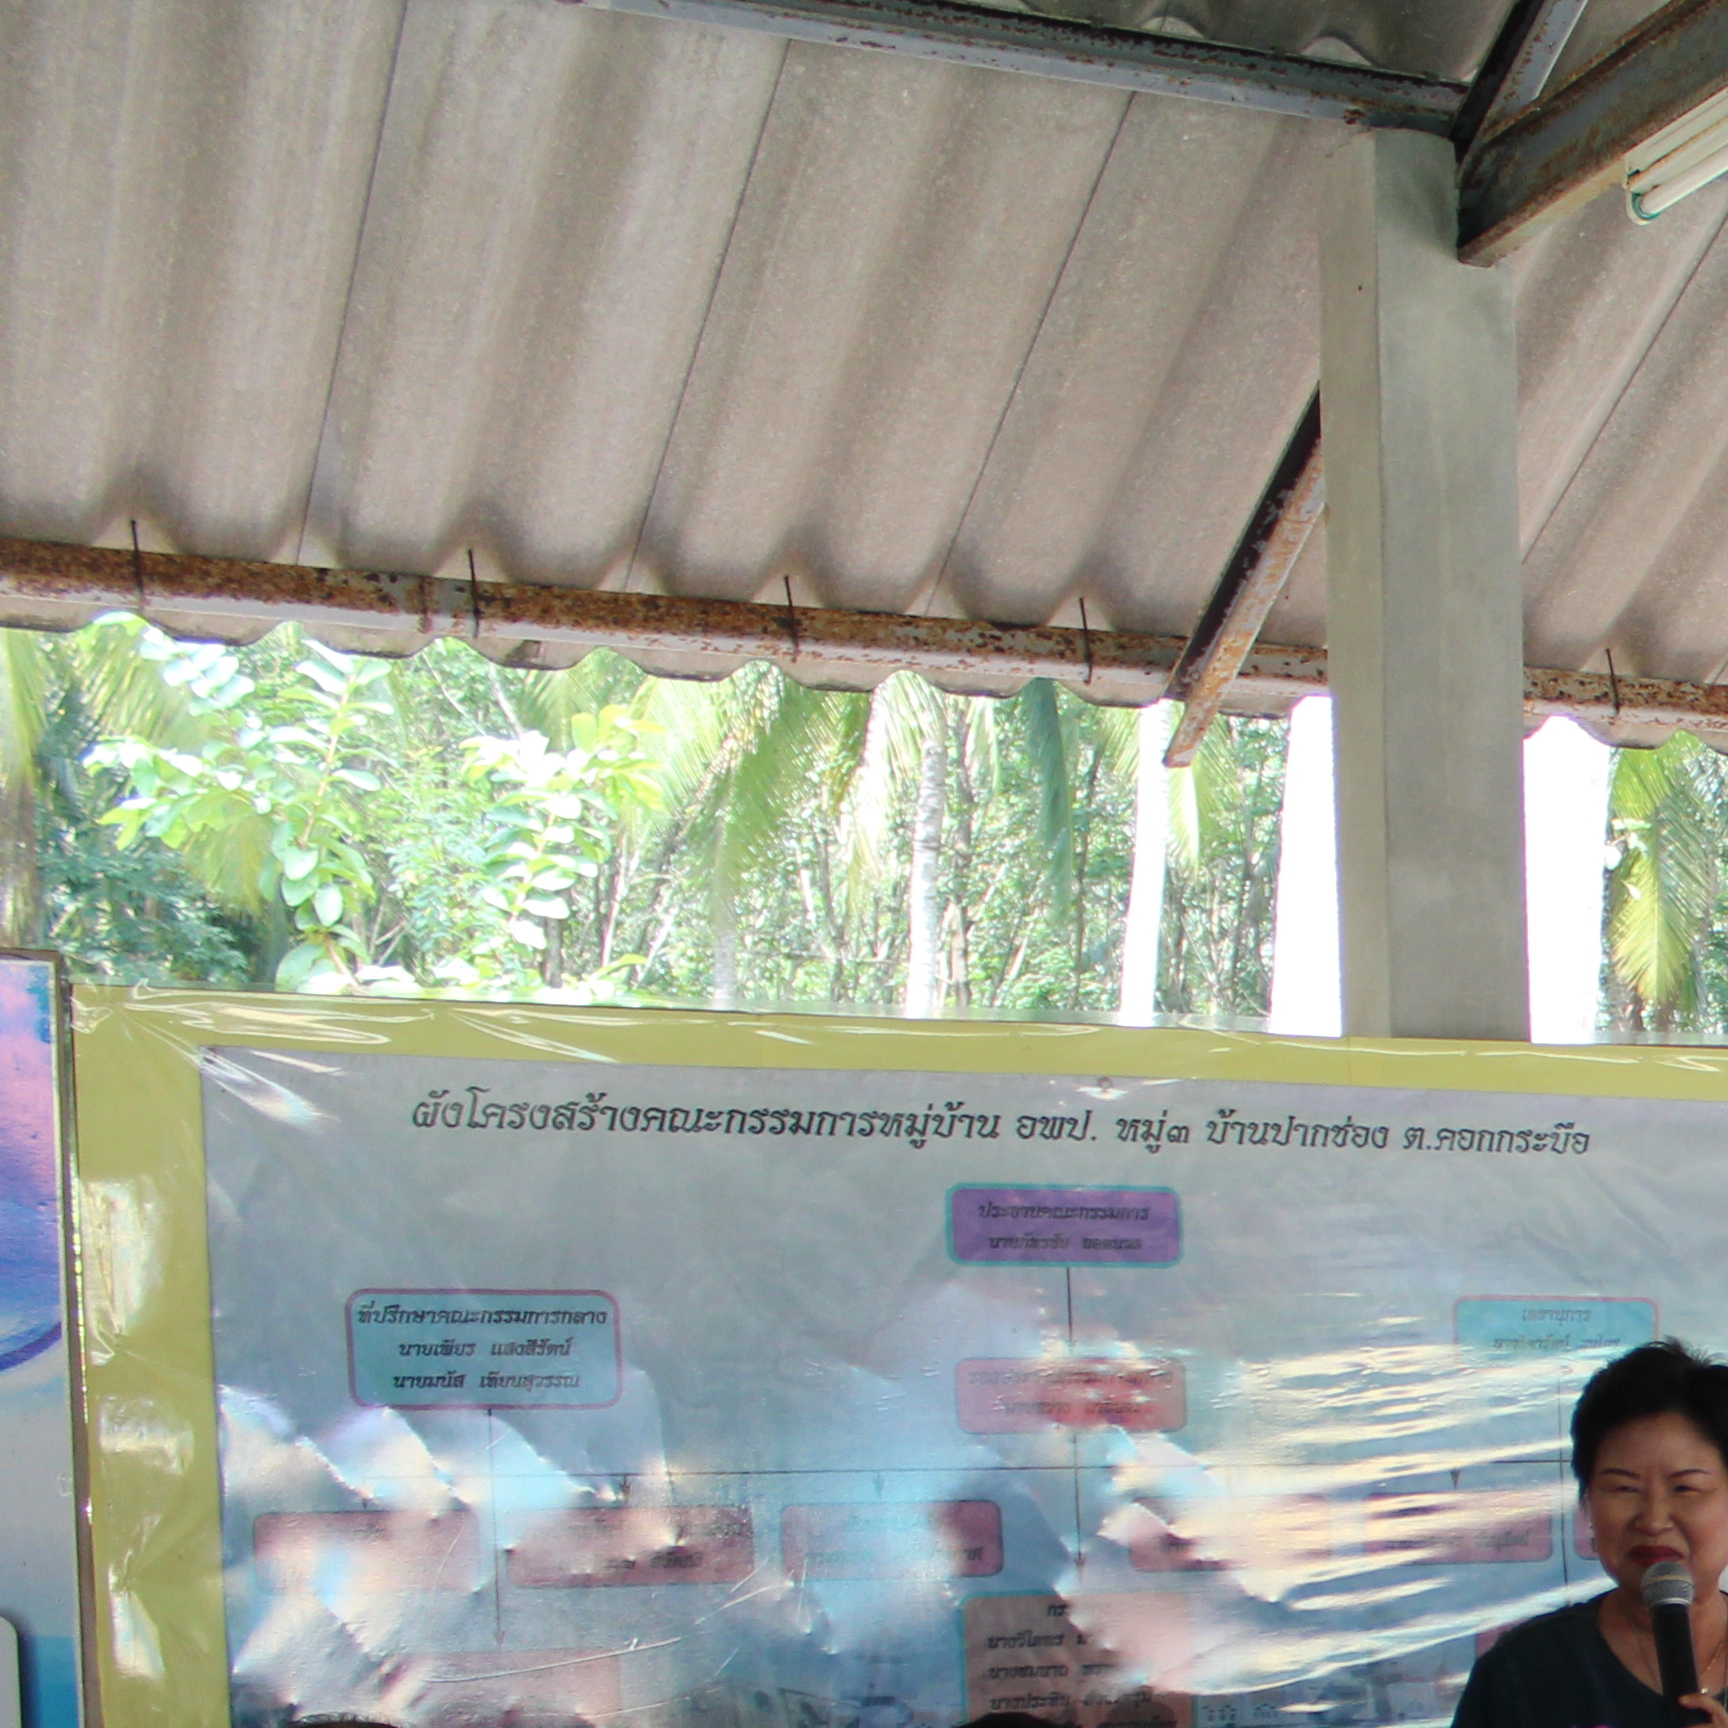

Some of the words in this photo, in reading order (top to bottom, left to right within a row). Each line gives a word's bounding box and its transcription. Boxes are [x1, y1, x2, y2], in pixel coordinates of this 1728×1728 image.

[411, 1086, 1000, 1150] ผังโครงสร้างคณะกรรมการหมู่บ้าน
[1017, 1110, 1097, 1142] อพป.
[1207, 1109, 1390, 1149] บ้านปากช่อง
[1403, 1120, 1591, 1156] ต.คอกกระบือ
[357, 1299, 608, 1325] ที่ปรึกษาคณะกรรมการกลาง
